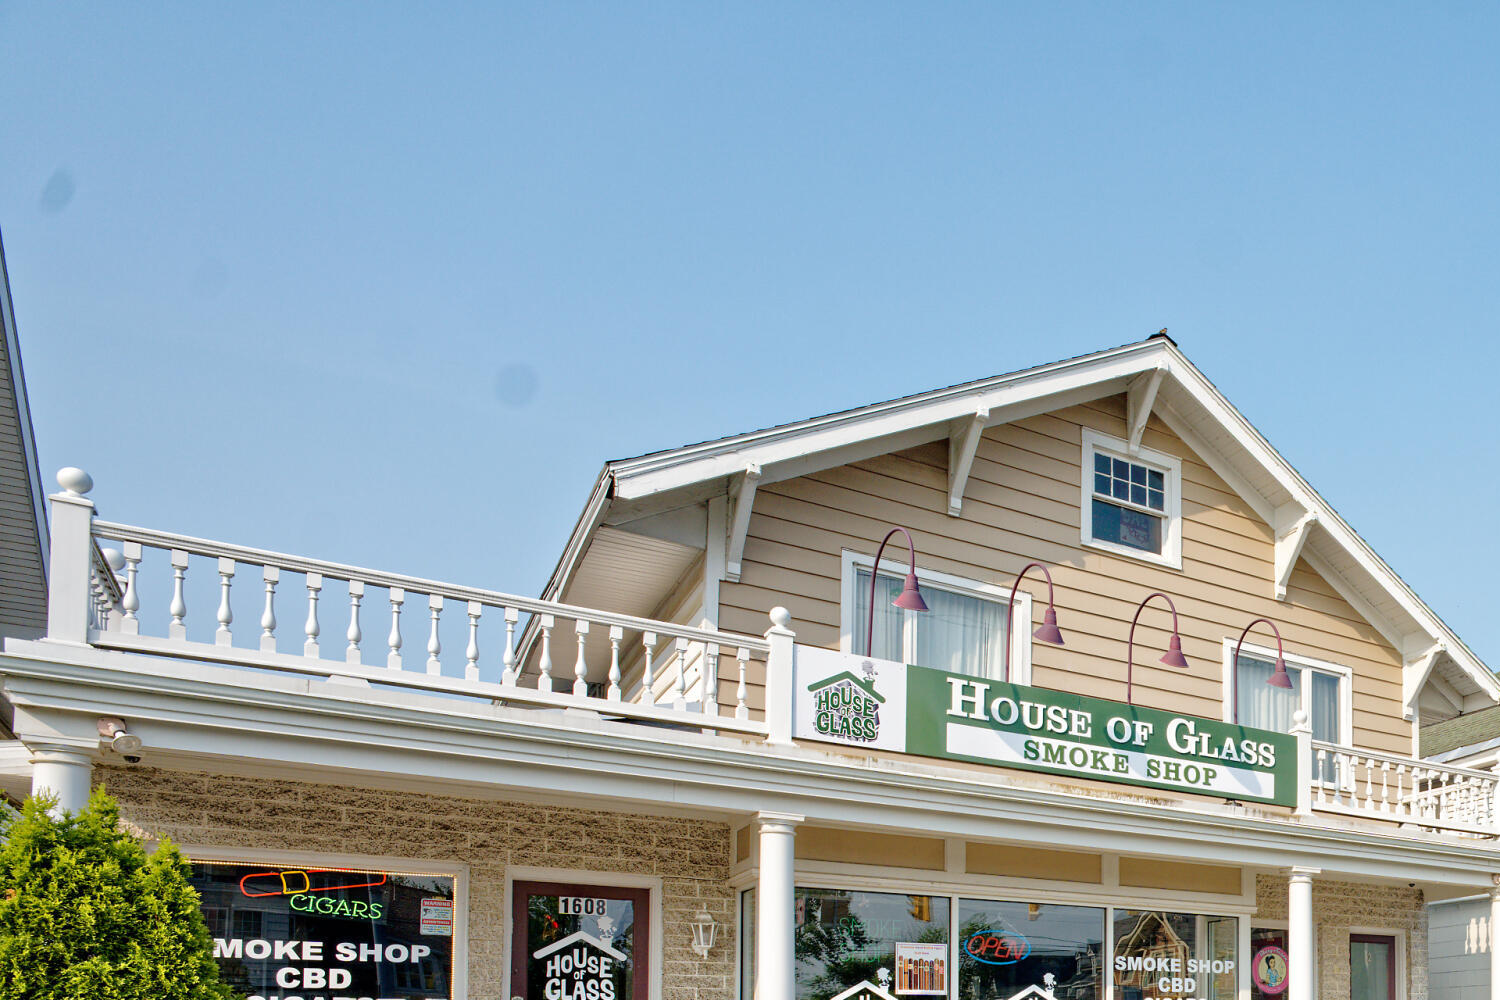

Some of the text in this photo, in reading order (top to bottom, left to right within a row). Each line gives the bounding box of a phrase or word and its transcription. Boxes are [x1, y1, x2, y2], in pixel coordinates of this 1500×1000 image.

[817, 687, 874, 717] HOUSE
[816, 711, 876, 739] GLASS
[1024, 739, 1217, 786] SMOKE SHOP
[290, 893, 384, 919] CIGARS
[561, 898, 606, 915] 1608
[840, 917, 901, 938] SMOKE
[213, 938, 431, 964] MOKE SHOP
[968, 935, 1026, 960] OPEN
[546, 947, 613, 978] HOUSE
[1115, 956, 1235, 974] SMOKE SHOP
[276, 967, 352, 990] CBD
[545, 978, 616, 1000] GLASS
[1158, 977, 1196, 993] CBD
